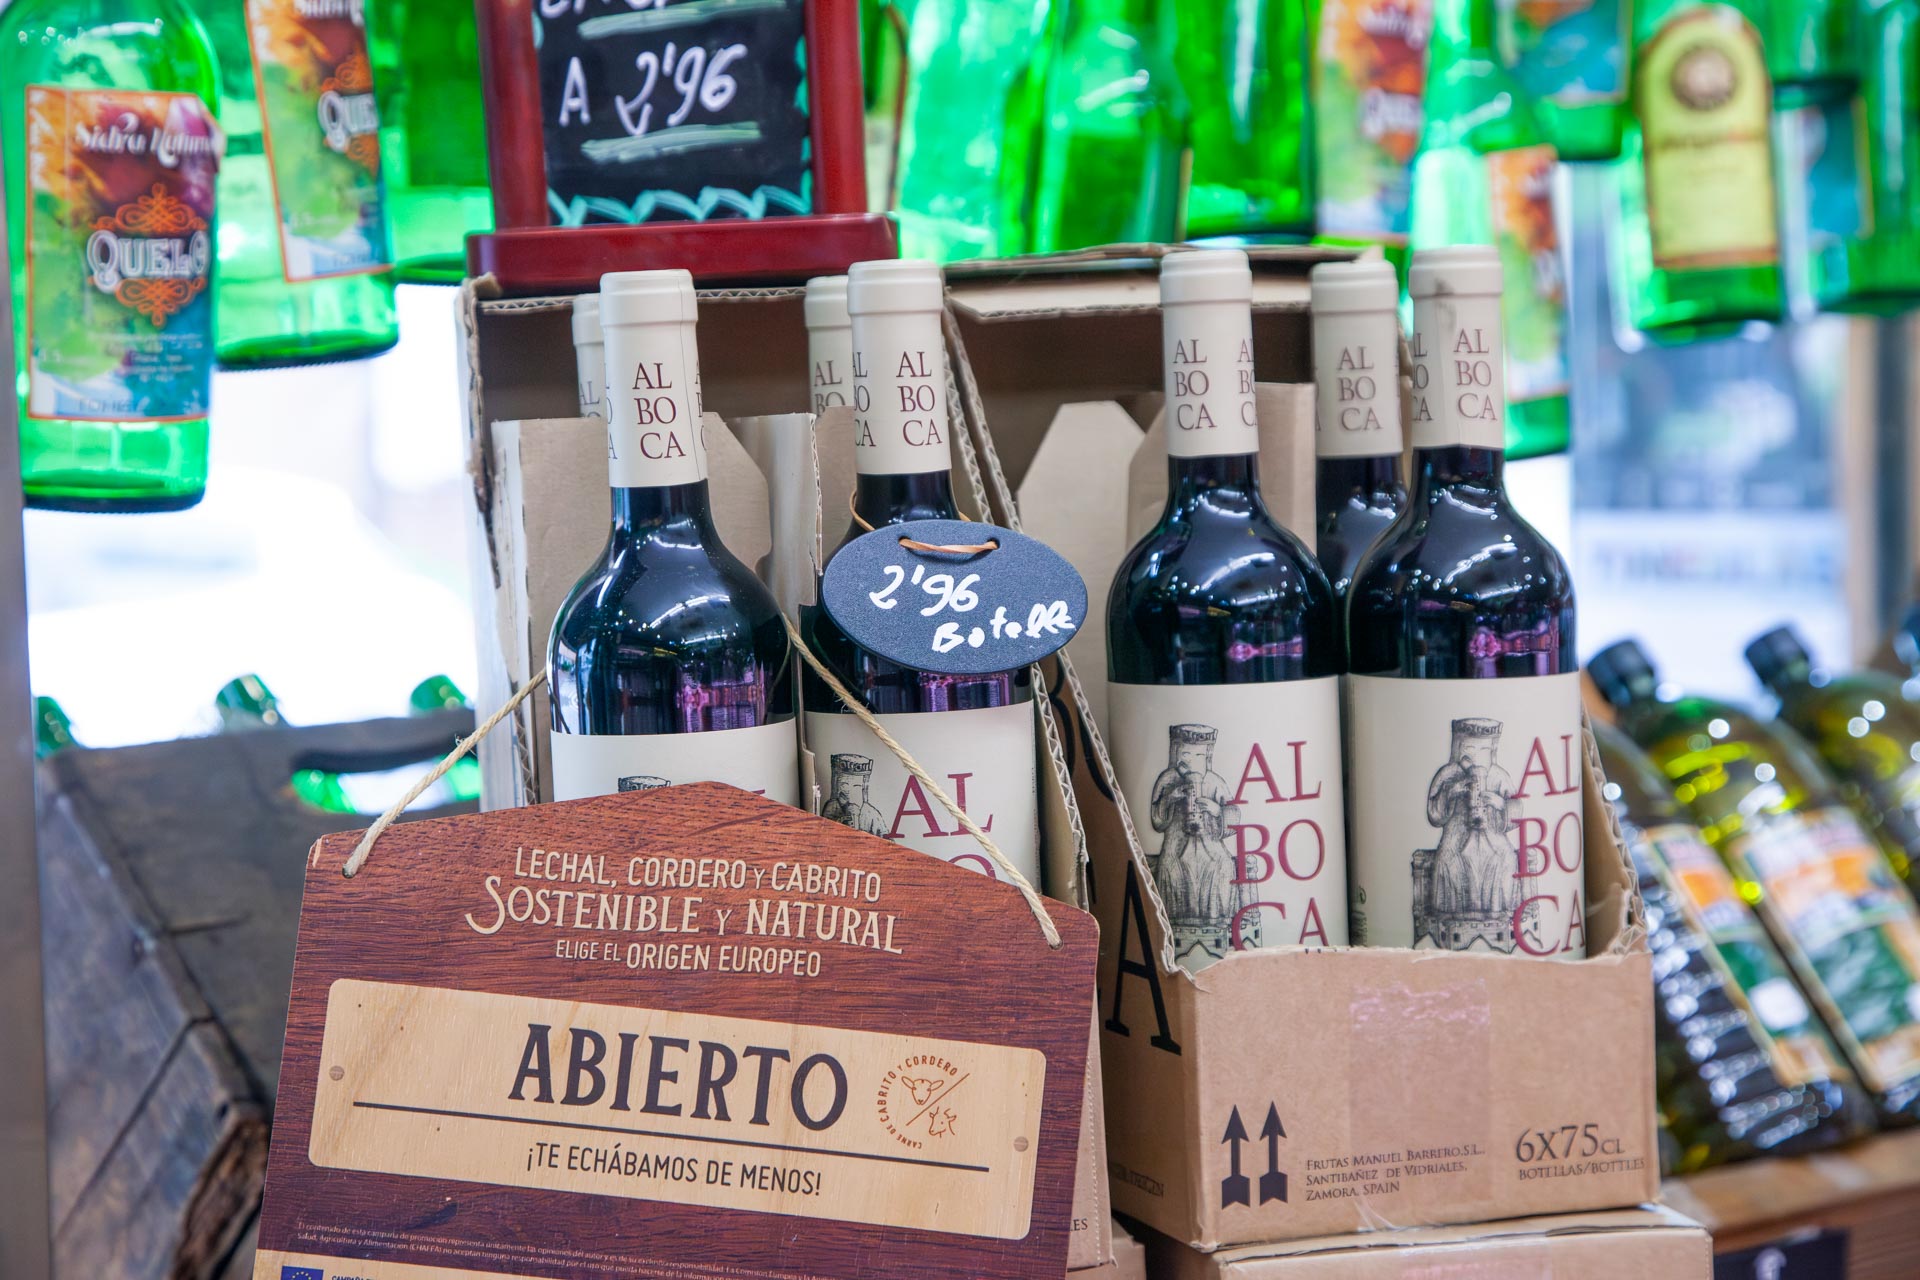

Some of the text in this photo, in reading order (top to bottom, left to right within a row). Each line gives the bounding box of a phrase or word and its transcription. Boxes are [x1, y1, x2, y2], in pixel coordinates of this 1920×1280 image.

[558, 57, 591, 127] A
[1172, 338, 1208, 364] AL
[1453, 327, 1491, 354] AL
[896, 351, 933, 378] AL
[1337, 346, 1375, 371] AL
[632, 362, 672, 390] AL
[814, 360, 842, 387] AL
[1173, 370, 1210, 397] BO
[1454, 360, 1492, 387] BO
[897, 384, 936, 412] BO
[1338, 375, 1377, 402] BO
[634, 396, 677, 425] BO
[1177, 402, 1218, 431] CA
[1340, 407, 1383, 432] CA
[1458, 392, 1498, 421] CA
[640, 431, 687, 459] CA
[902, 418, 943, 447] CA
[869, 564, 981, 617] 2'96
[1226, 740, 1322, 806] AL
[1511, 734, 1581, 800] AL
[884, 772, 994, 840] AL
[1227, 818, 1326, 885] BO
[1511, 811, 1583, 878] BO
[514, 847, 882, 903] LECHAL, CORDERO Y CABRITO
[464, 875, 904, 955] SOSTENIBLE Y NATURAL
[1231, 897, 1330, 952] CA
[1512, 889, 1586, 957] CA
[556, 940, 821, 978] ELIGE EL ORIGEN EUROPEO
[507, 1023, 849, 1132] ABIERTO
[905, 1055, 958, 1076] CORDERO
[877, 1071, 897, 1123] CABRITO
[886, 1124, 897, 1135] DE
[527, 1142, 821, 1197] ¡TE ECHÁBAMOS DE MENOS!
[1386, 1167, 1401, 1179] DE
[1363, 1181, 1400, 1195] SPAIN
